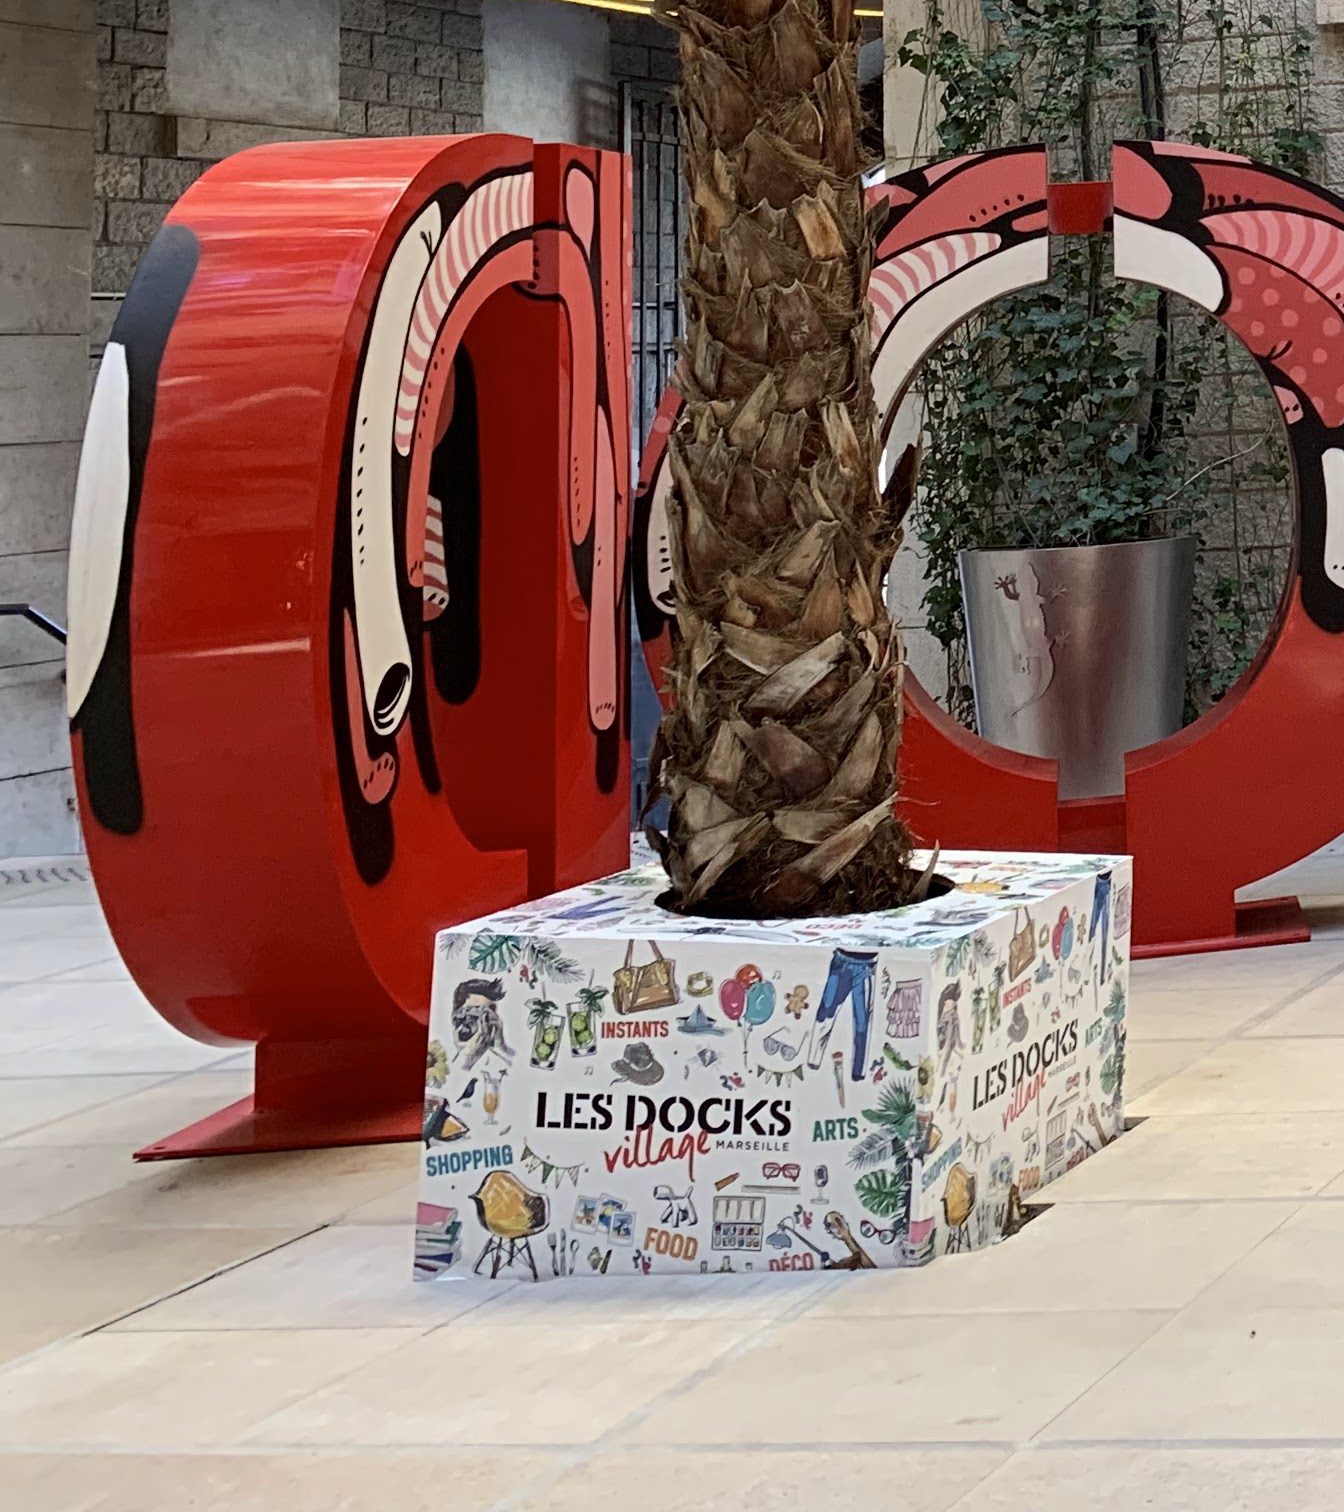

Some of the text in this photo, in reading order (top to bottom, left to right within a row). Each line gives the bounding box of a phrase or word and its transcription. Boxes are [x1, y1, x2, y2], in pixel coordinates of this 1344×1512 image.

[601, 1021, 669, 1039] INSTANTS
[973, 1018, 1079, 1111] LES DOCKS
[536, 1092, 791, 1136] LES DOCKS
[812, 1117, 859, 1142] ARTS
[426, 1144, 514, 1177] SHOPPING
[604, 1123, 711, 1182] village
[715, 1139, 790, 1152] MARSEILLE
[643, 1227, 699, 1262] FOOD
[768, 1251, 815, 1272] DÉCO
